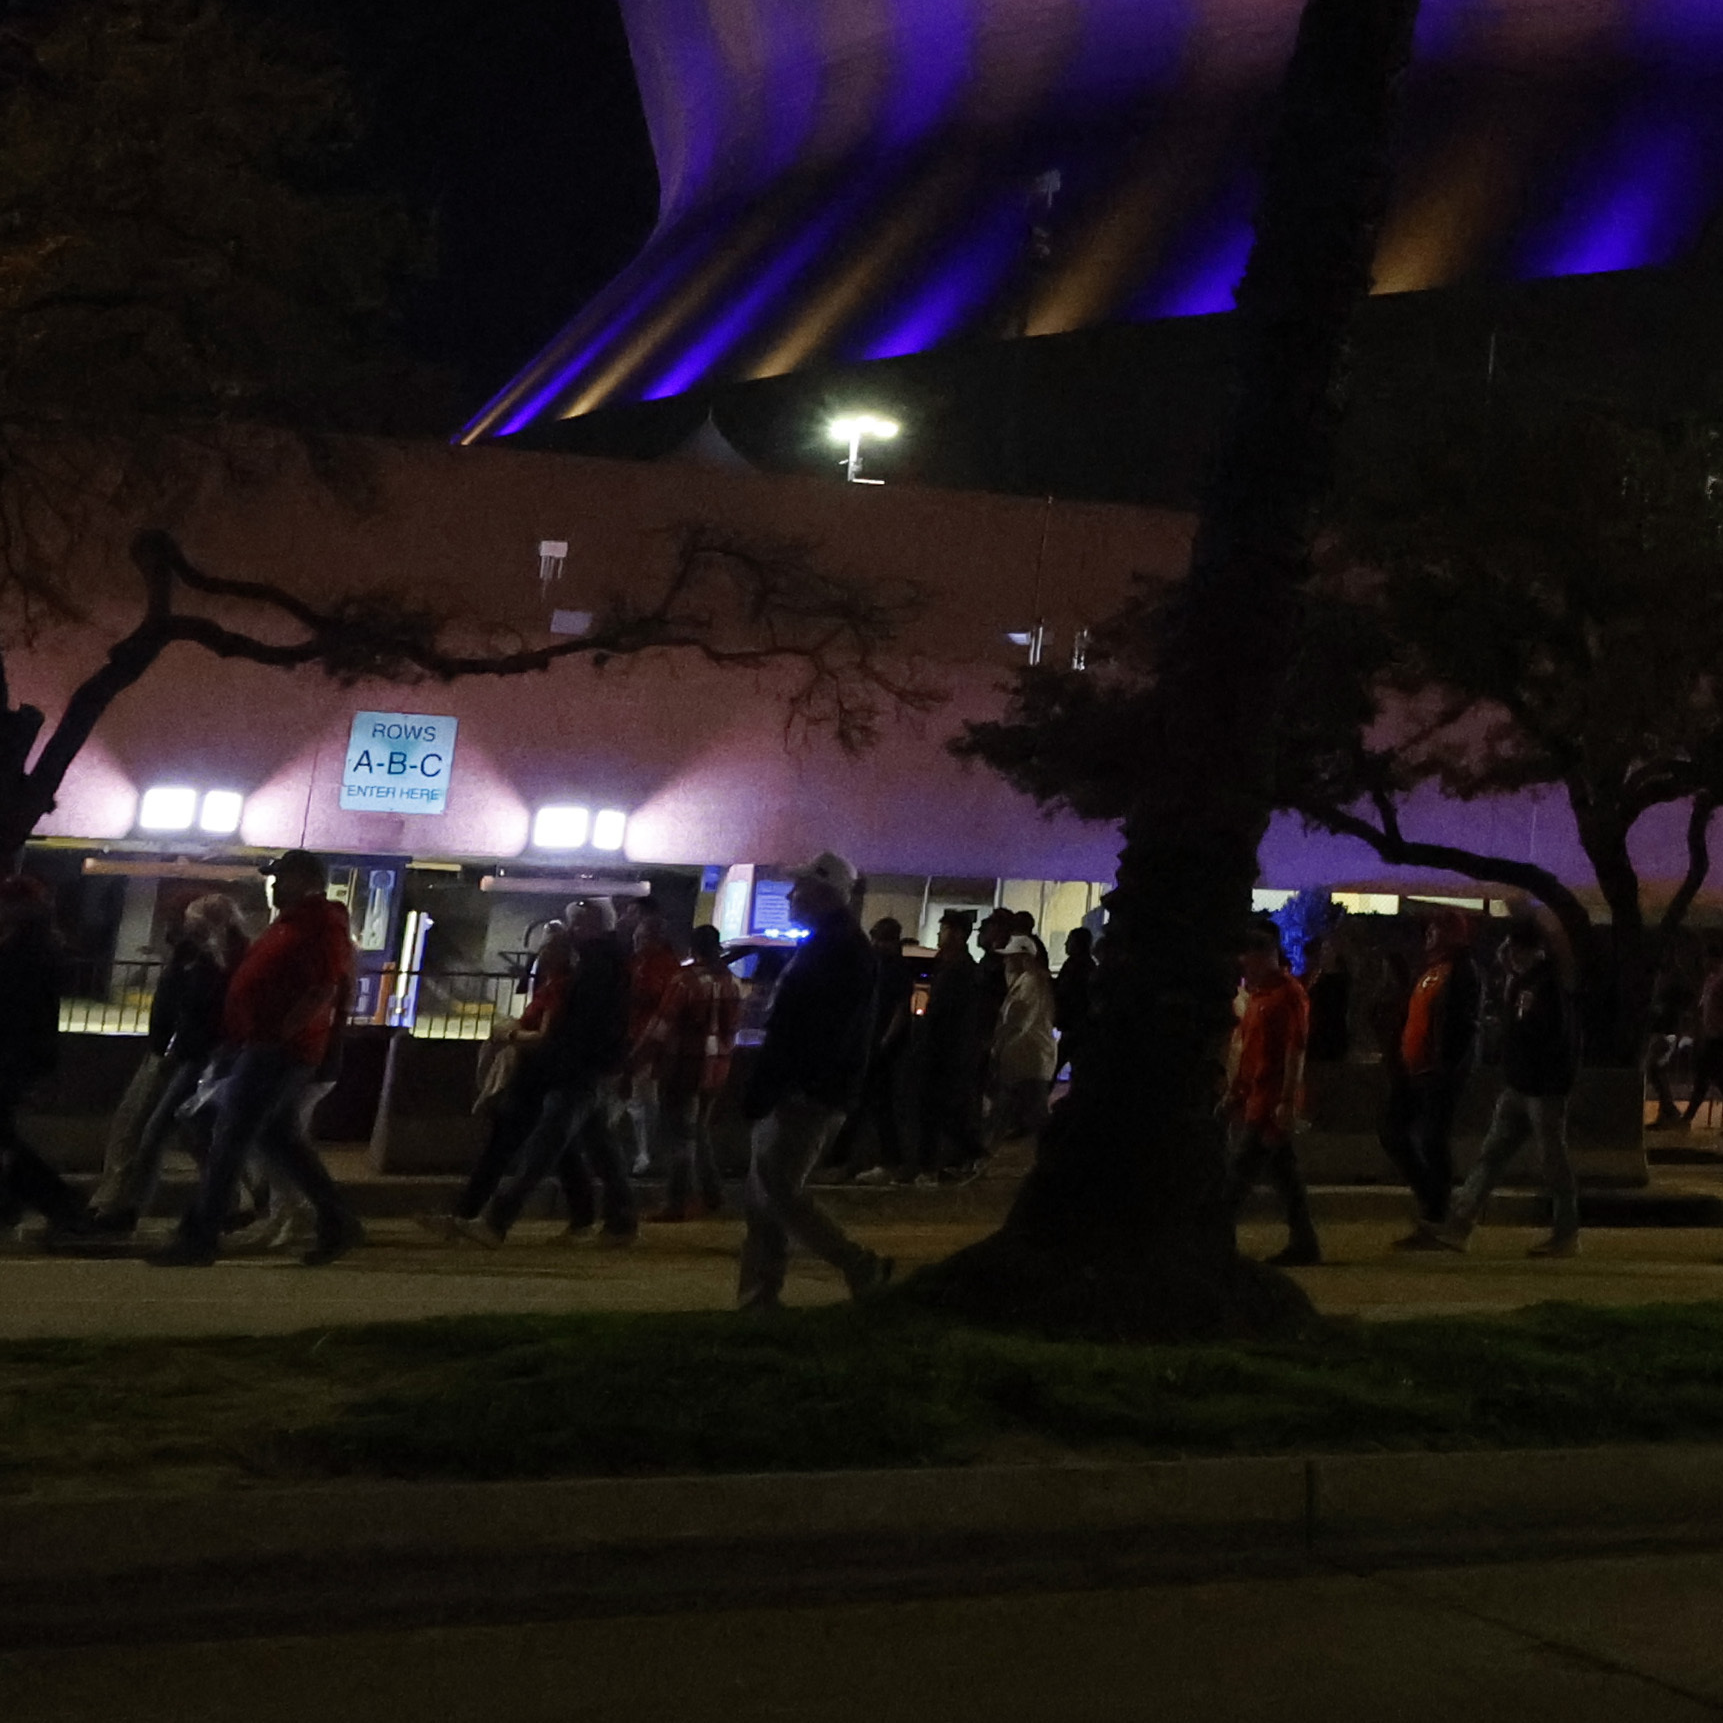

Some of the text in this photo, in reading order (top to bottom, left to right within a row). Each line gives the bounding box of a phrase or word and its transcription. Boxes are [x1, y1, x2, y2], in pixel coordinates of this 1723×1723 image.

[371, 722, 437, 742] ROWS
[352, 749, 443, 778] A-B-C
[346, 784, 440, 801] ENTER HERE
